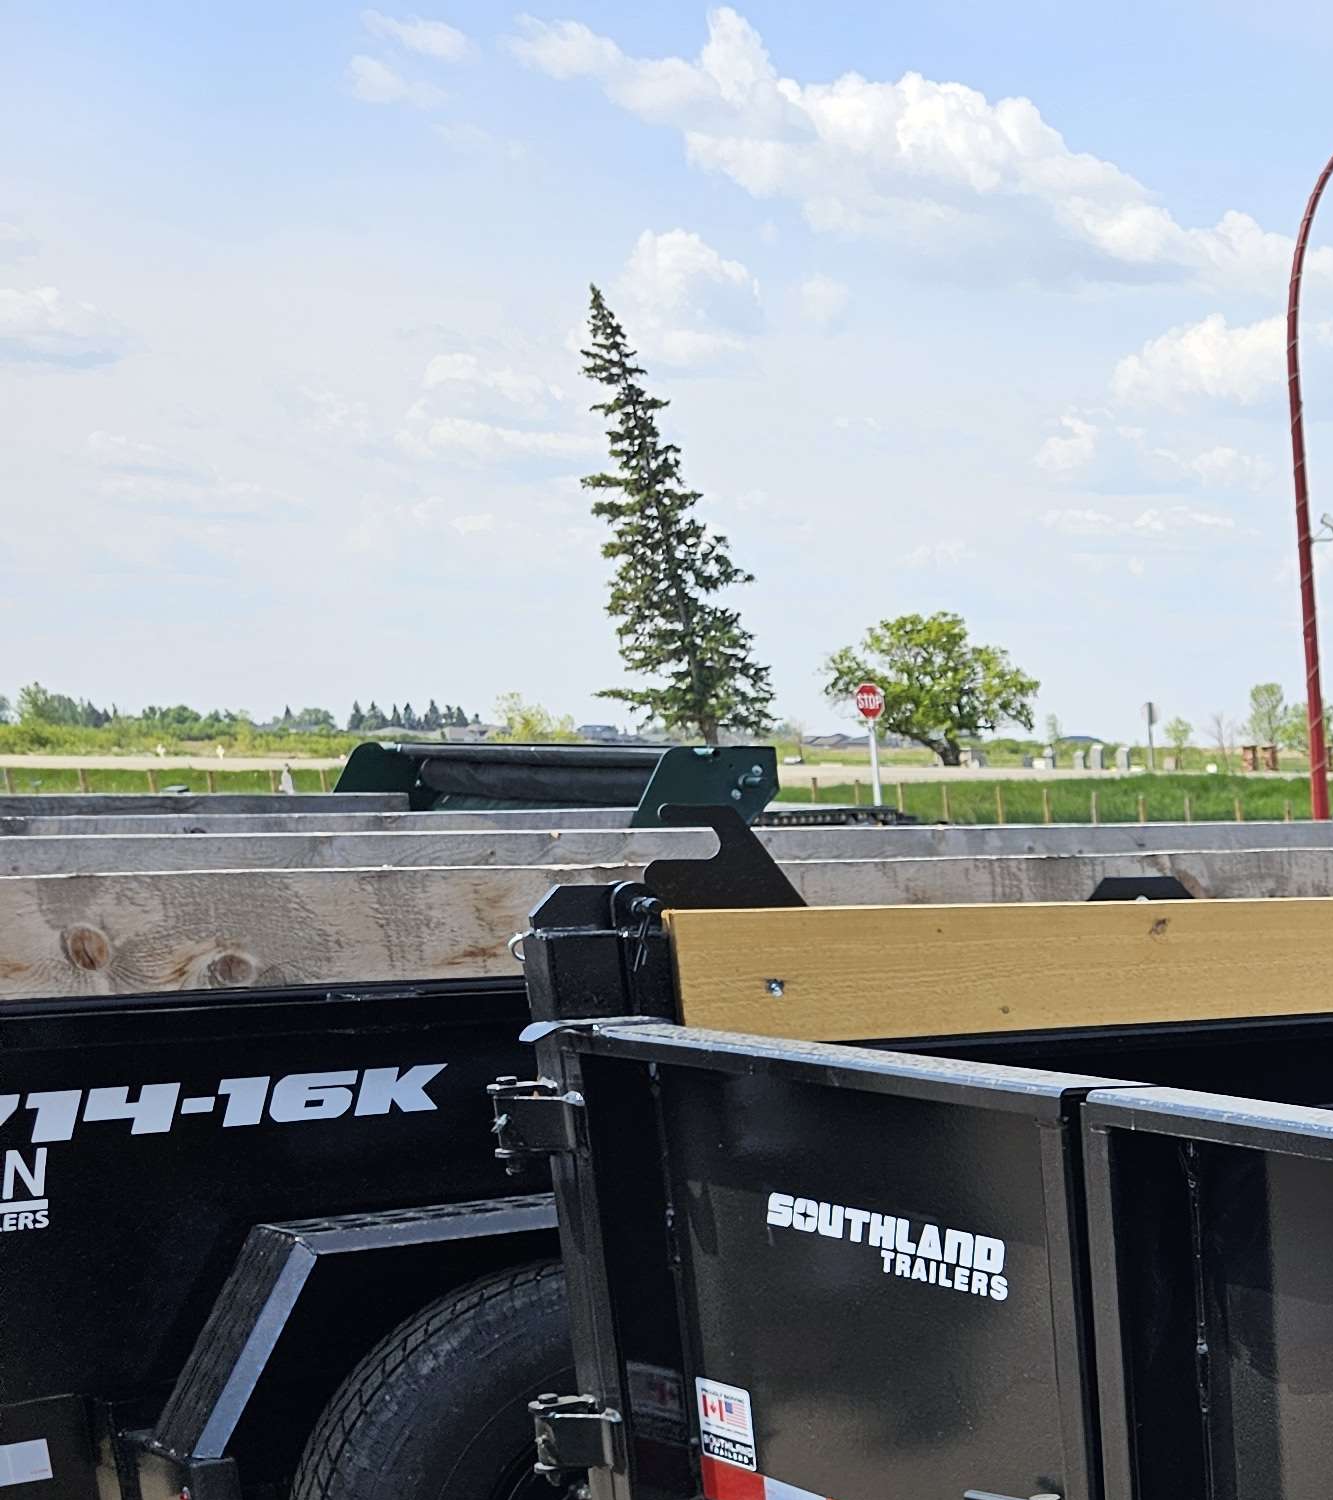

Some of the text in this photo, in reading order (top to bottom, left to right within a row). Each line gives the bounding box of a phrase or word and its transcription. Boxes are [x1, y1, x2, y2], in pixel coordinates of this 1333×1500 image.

[857, 692, 883, 709] STOP
[0, 1064, 448, 1144] 14-16K
[766, 1192, 1006, 1274] SOUTHLAND
[880, 1249, 1009, 1301] TRAILERS
